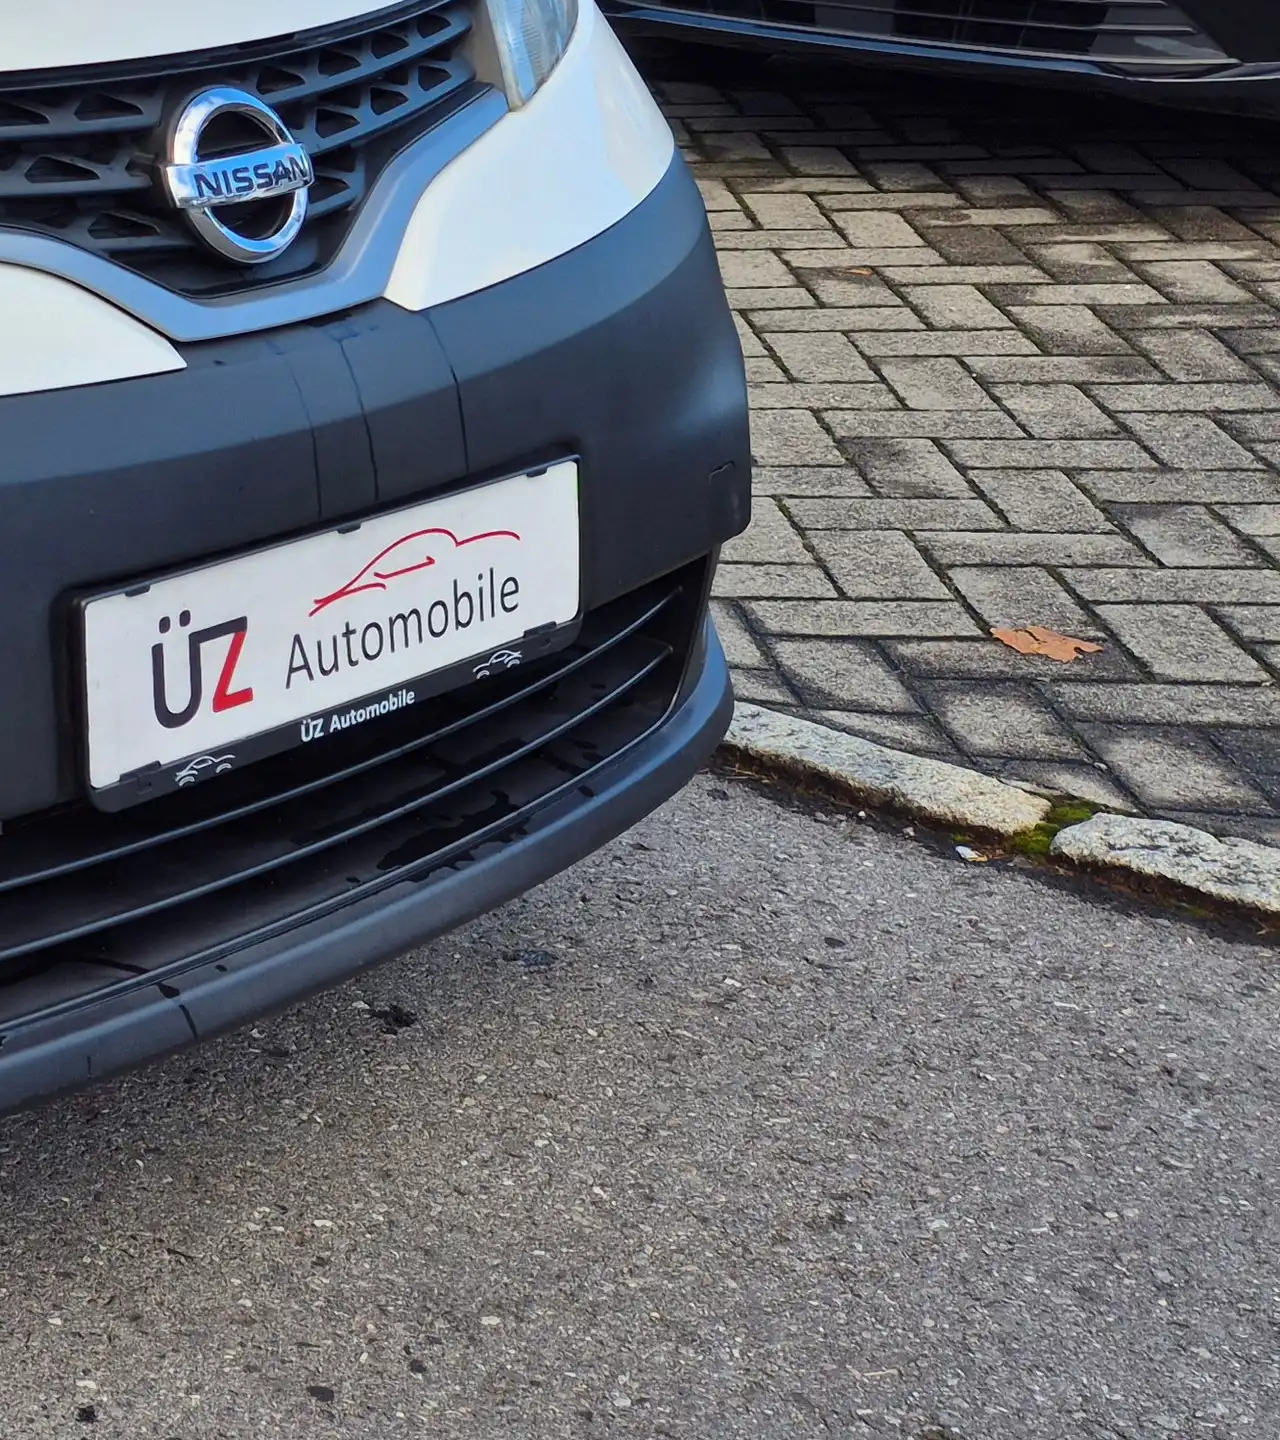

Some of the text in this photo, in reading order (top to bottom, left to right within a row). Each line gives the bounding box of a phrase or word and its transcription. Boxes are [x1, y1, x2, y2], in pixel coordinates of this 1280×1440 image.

[194, 155, 310, 199] NISSAN
[151, 567, 521, 730] ÜZ Automobile
[300, 689, 416, 742] ÜZ Automobile
